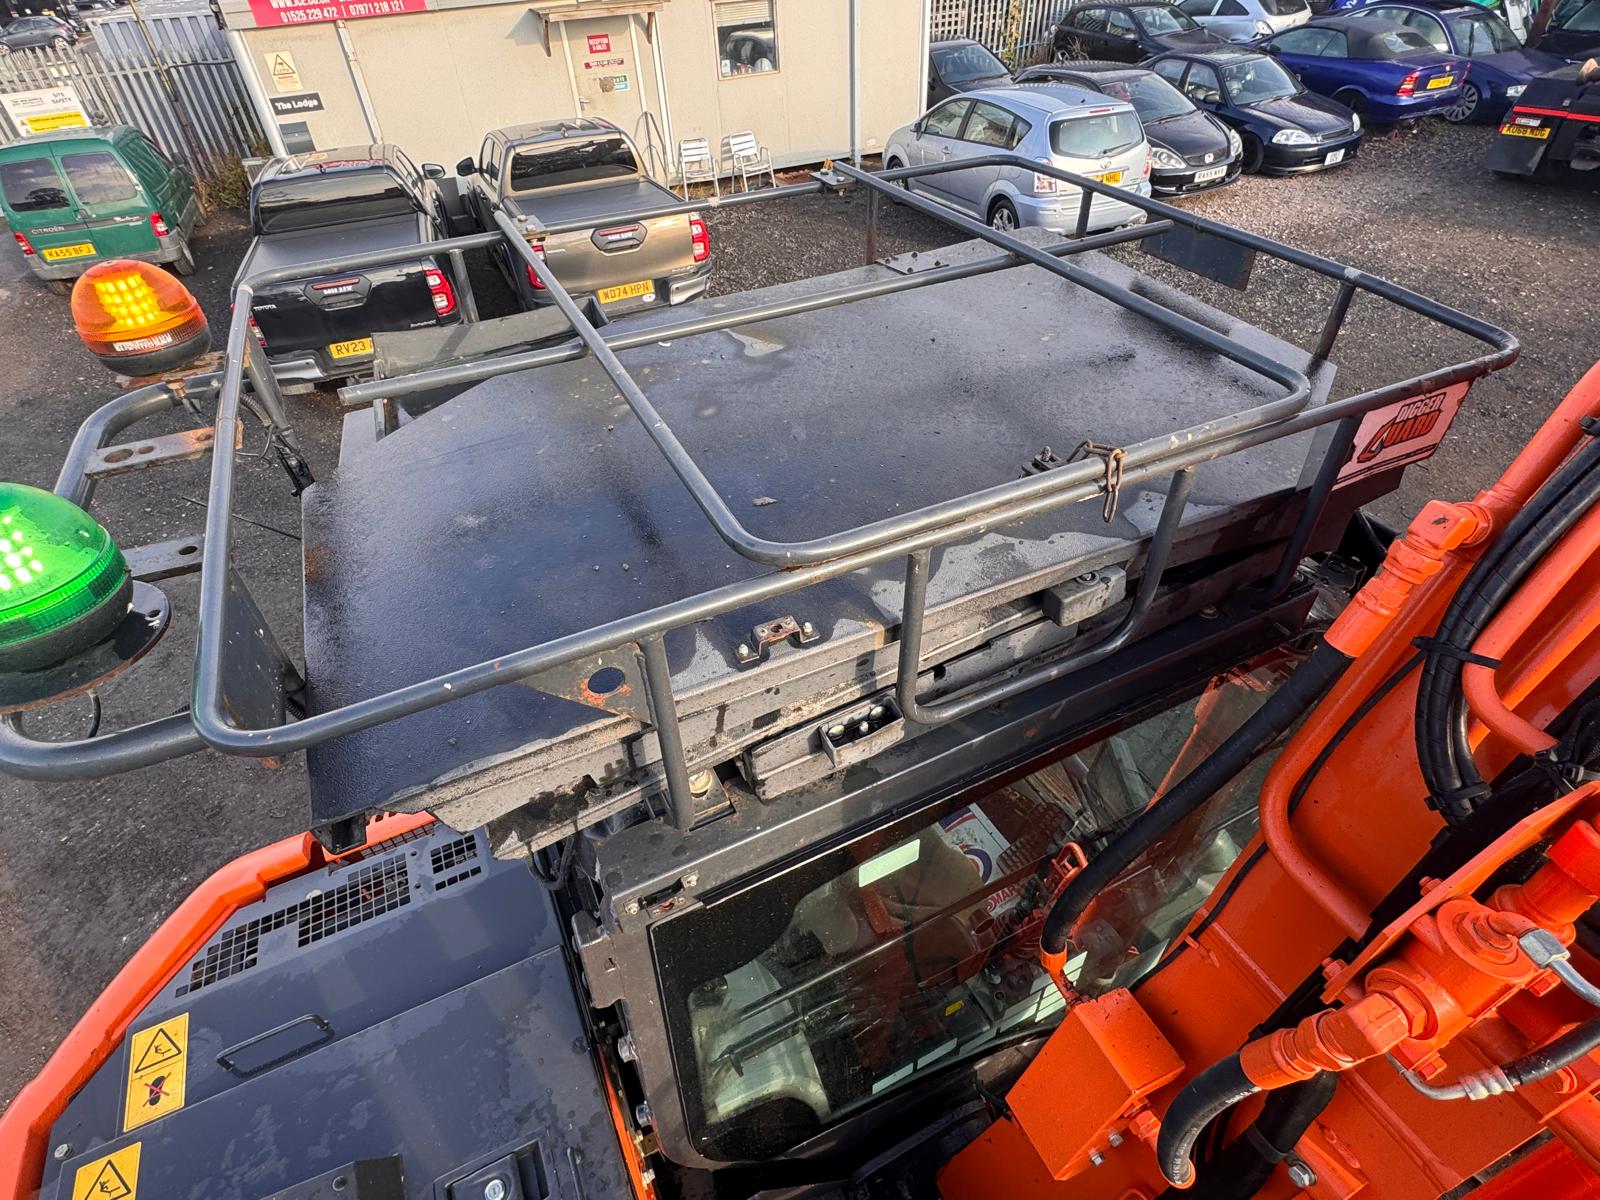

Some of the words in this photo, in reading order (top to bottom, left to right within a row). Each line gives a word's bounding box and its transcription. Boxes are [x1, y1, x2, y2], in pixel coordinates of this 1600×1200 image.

[280, 9, 307, 23] 01525
[305, 8, 323, 20] 229
[323, 6, 339, 18] 472
[374, 1, 390, 13] 218
[390, 0, 404, 12] 121
[275, 101, 292, 110] The
[292, 98, 318, 109] Lodge
[630, 281, 649, 295] HPN
[336, 341, 366, 356] RV23
[1394, 392, 1446, 424] DIGGER
